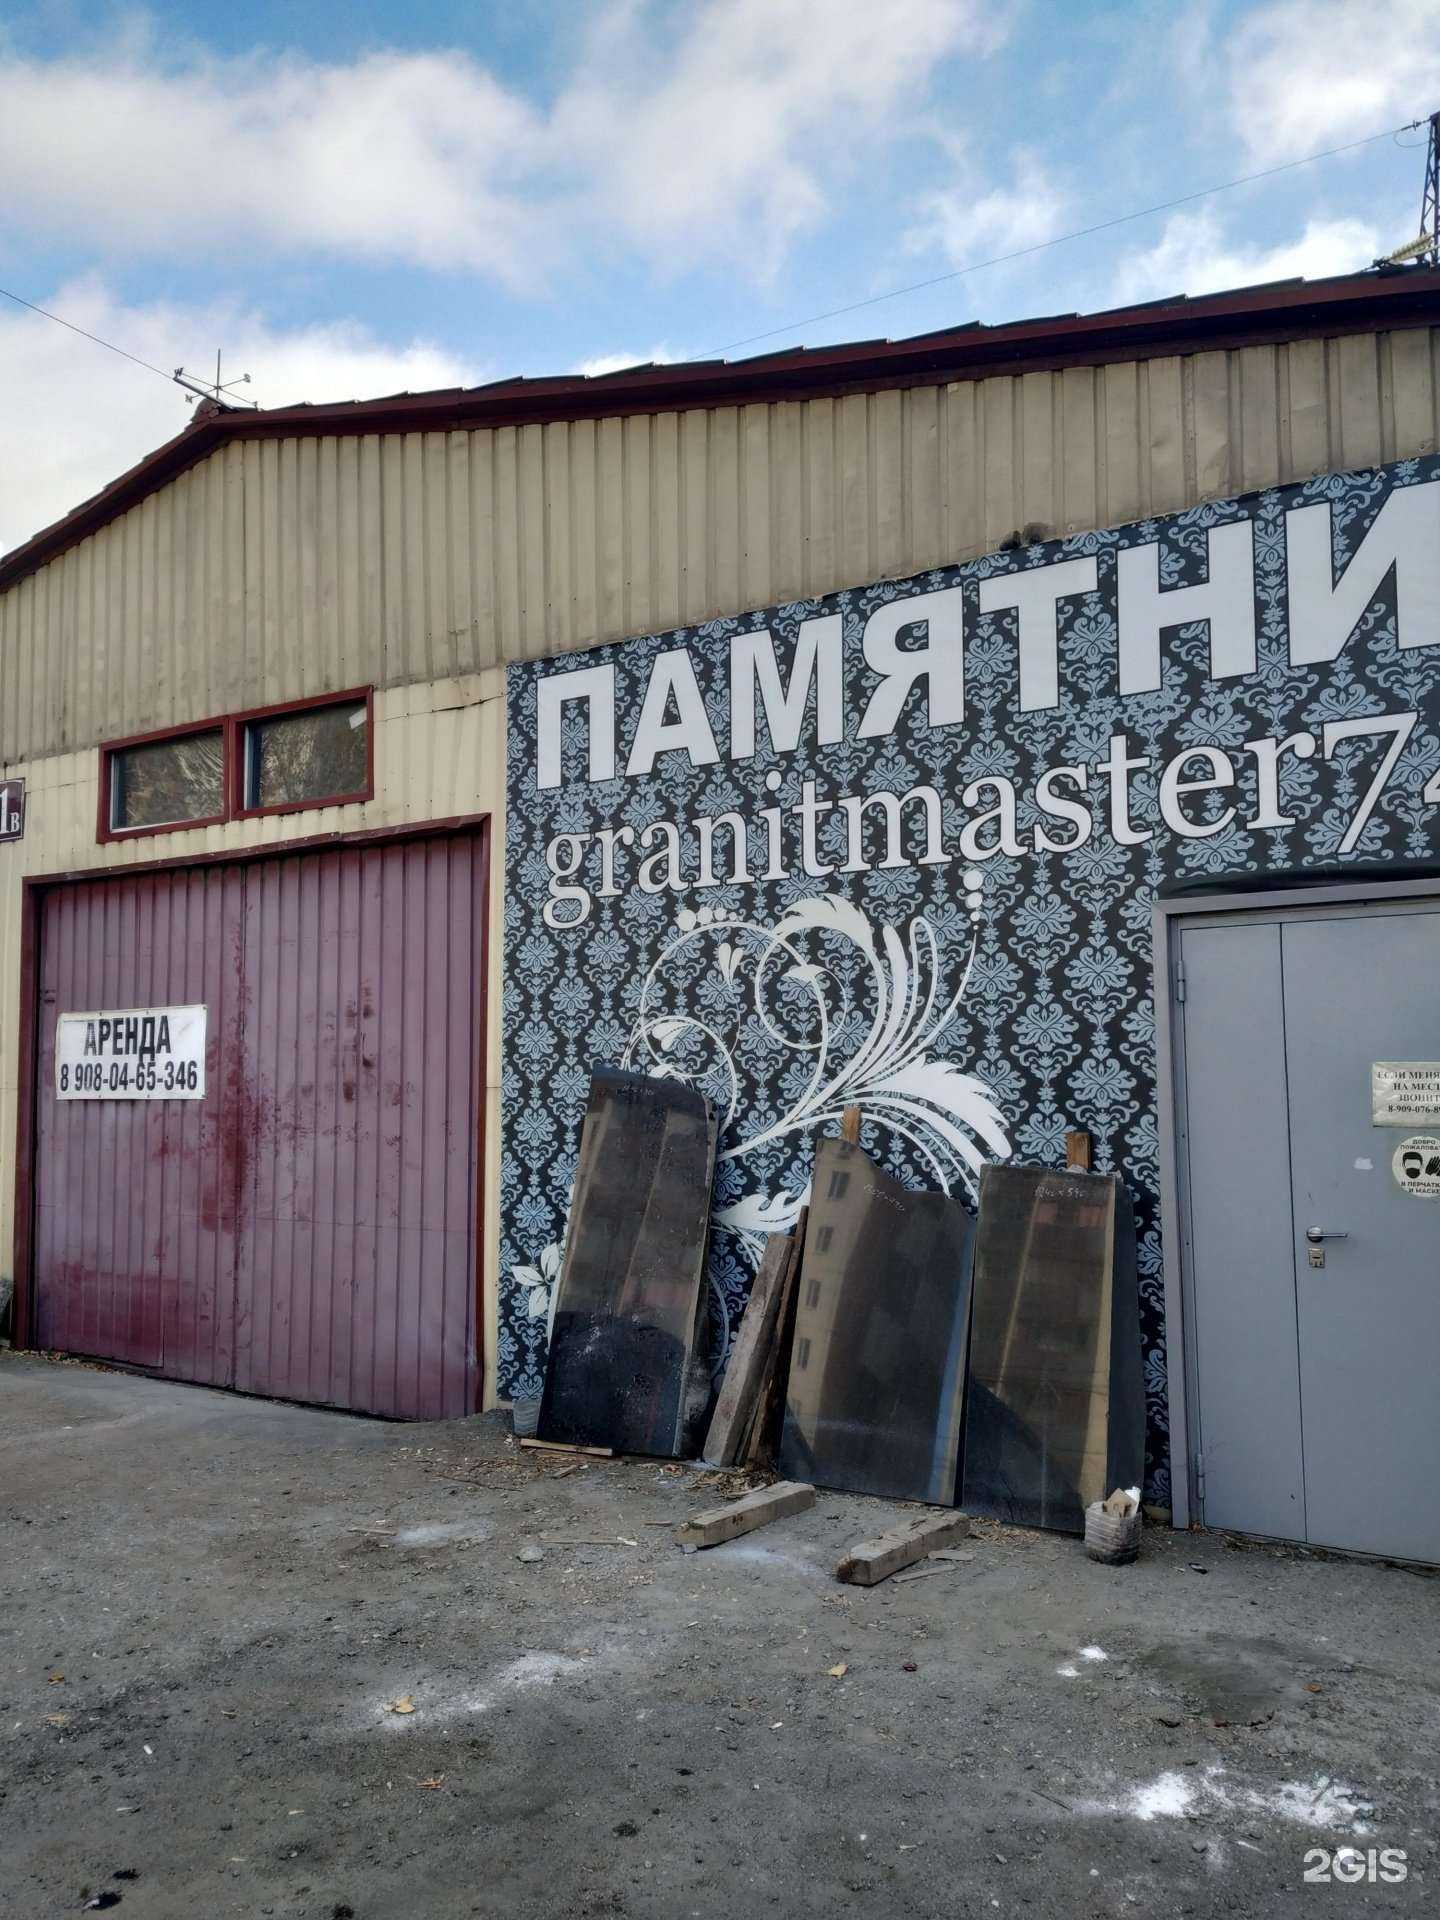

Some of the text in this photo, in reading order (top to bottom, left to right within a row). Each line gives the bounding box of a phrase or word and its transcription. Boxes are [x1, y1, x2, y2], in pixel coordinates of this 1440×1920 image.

[542, 711, 1440, 929] granitmaster7
[83, 1015, 172, 1064] АРЕНДА
[60, 1060, 198, 1092] 8 908-04-65-346
